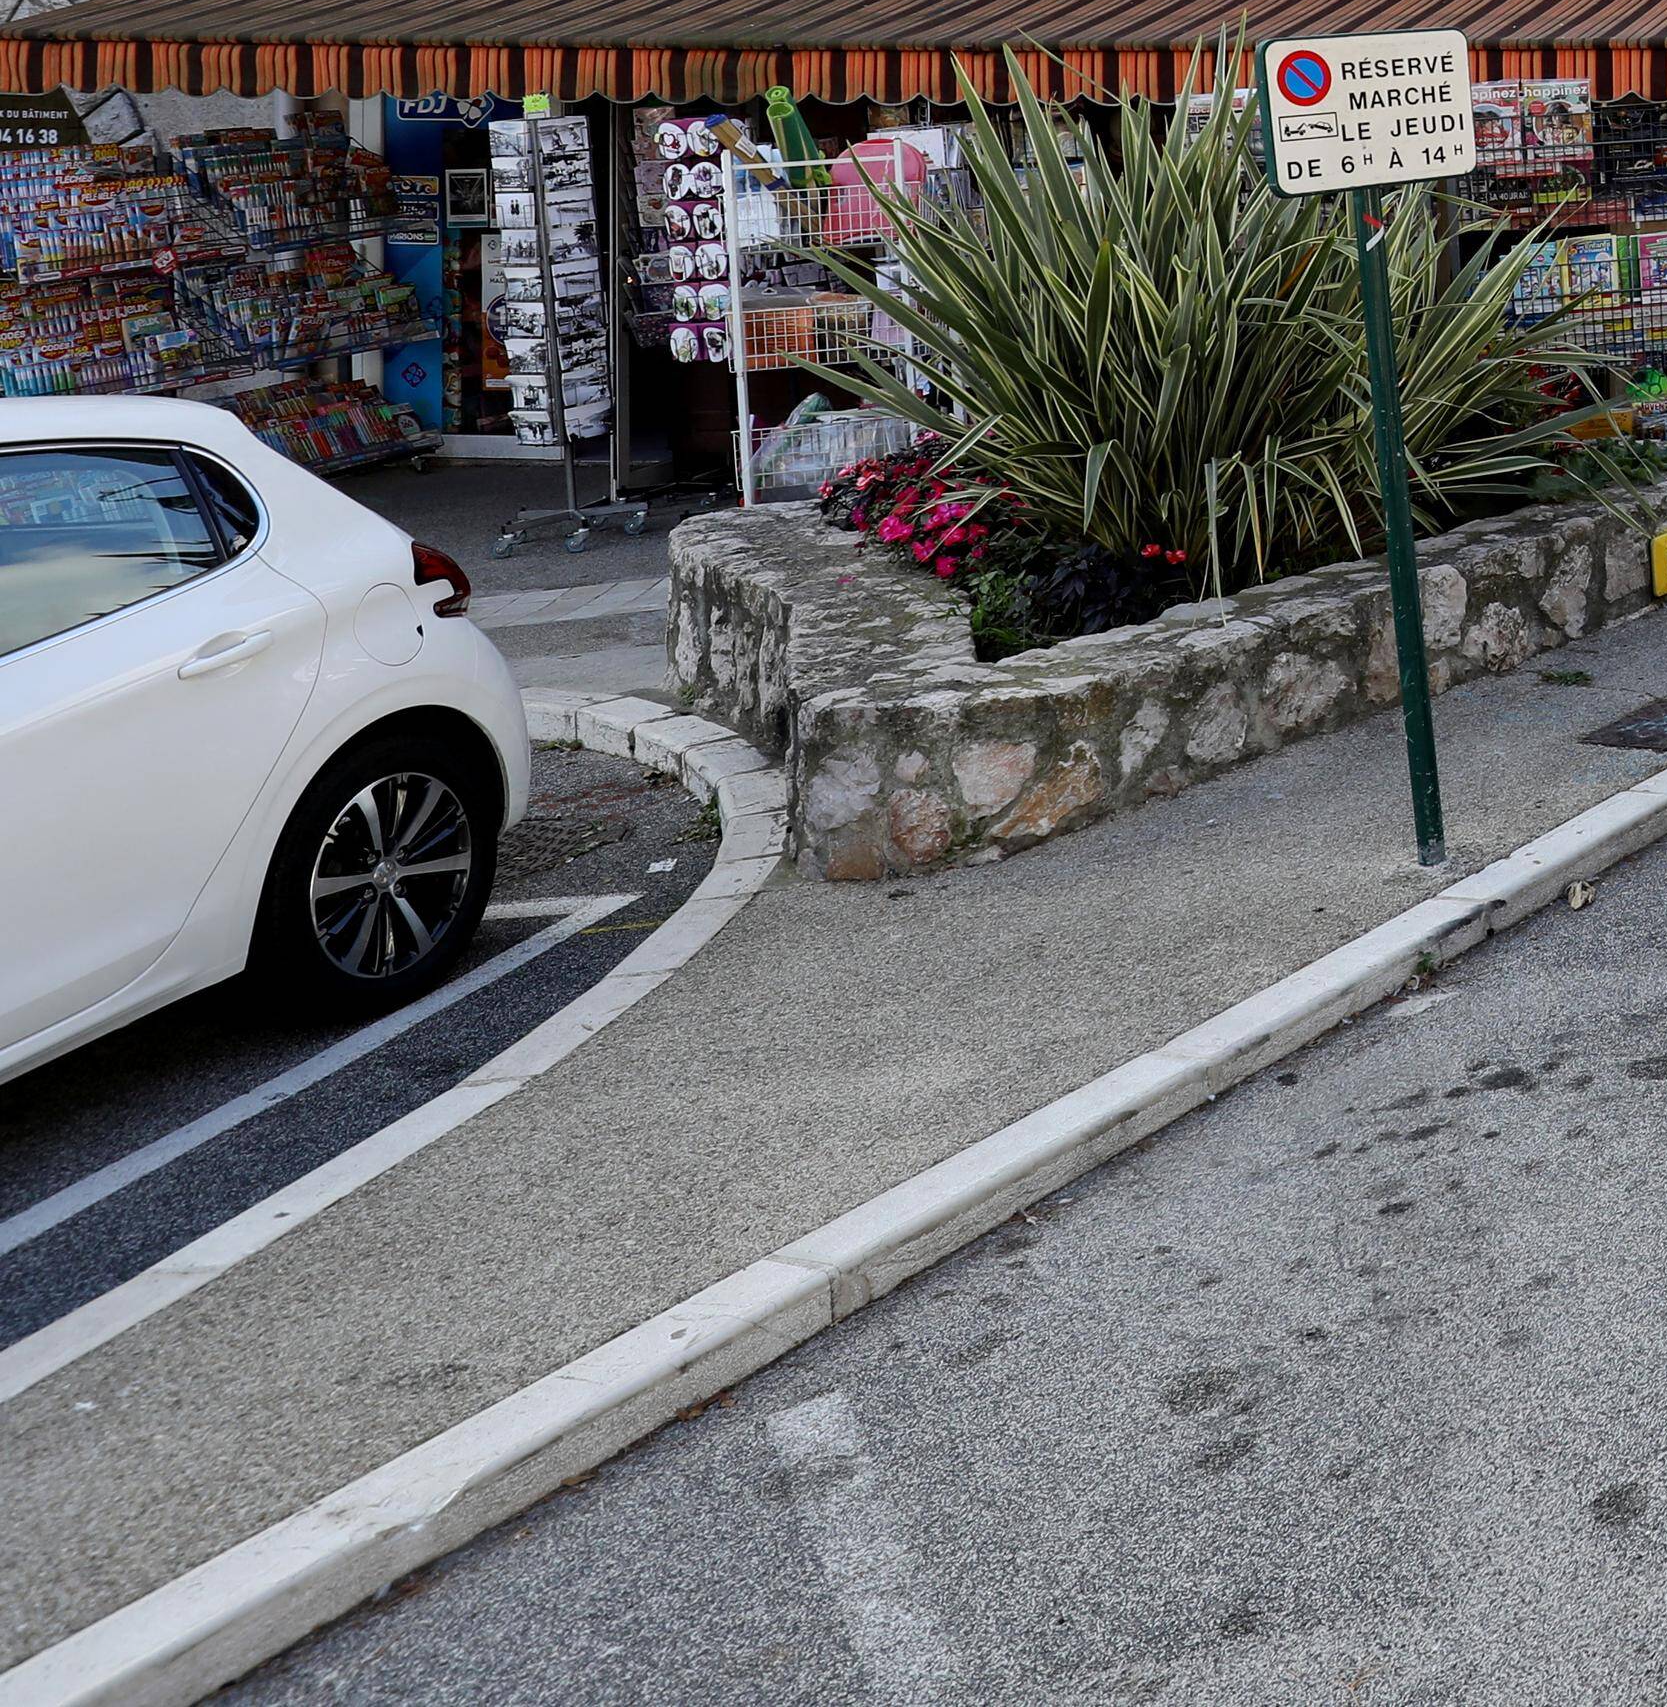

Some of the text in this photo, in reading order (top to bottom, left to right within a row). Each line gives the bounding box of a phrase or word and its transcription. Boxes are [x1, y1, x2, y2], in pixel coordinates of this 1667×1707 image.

[1341, 51, 1454, 80] RÉSERVÉ
[1349, 81, 1452, 110] MARCHÉ
[1523, 85, 1588, 99] happinez
[7, 111, 19, 119] DU
[22, 109, 69, 120] BÂTIMENT
[403, 96, 447, 114] FDJ
[16, 129, 34, 143] 16
[38, 129, 58, 143] 38
[1341, 113, 1464, 142] LE JEUDI
[1287, 159, 1322, 180] DE
[1389, 147, 1403, 169] À
